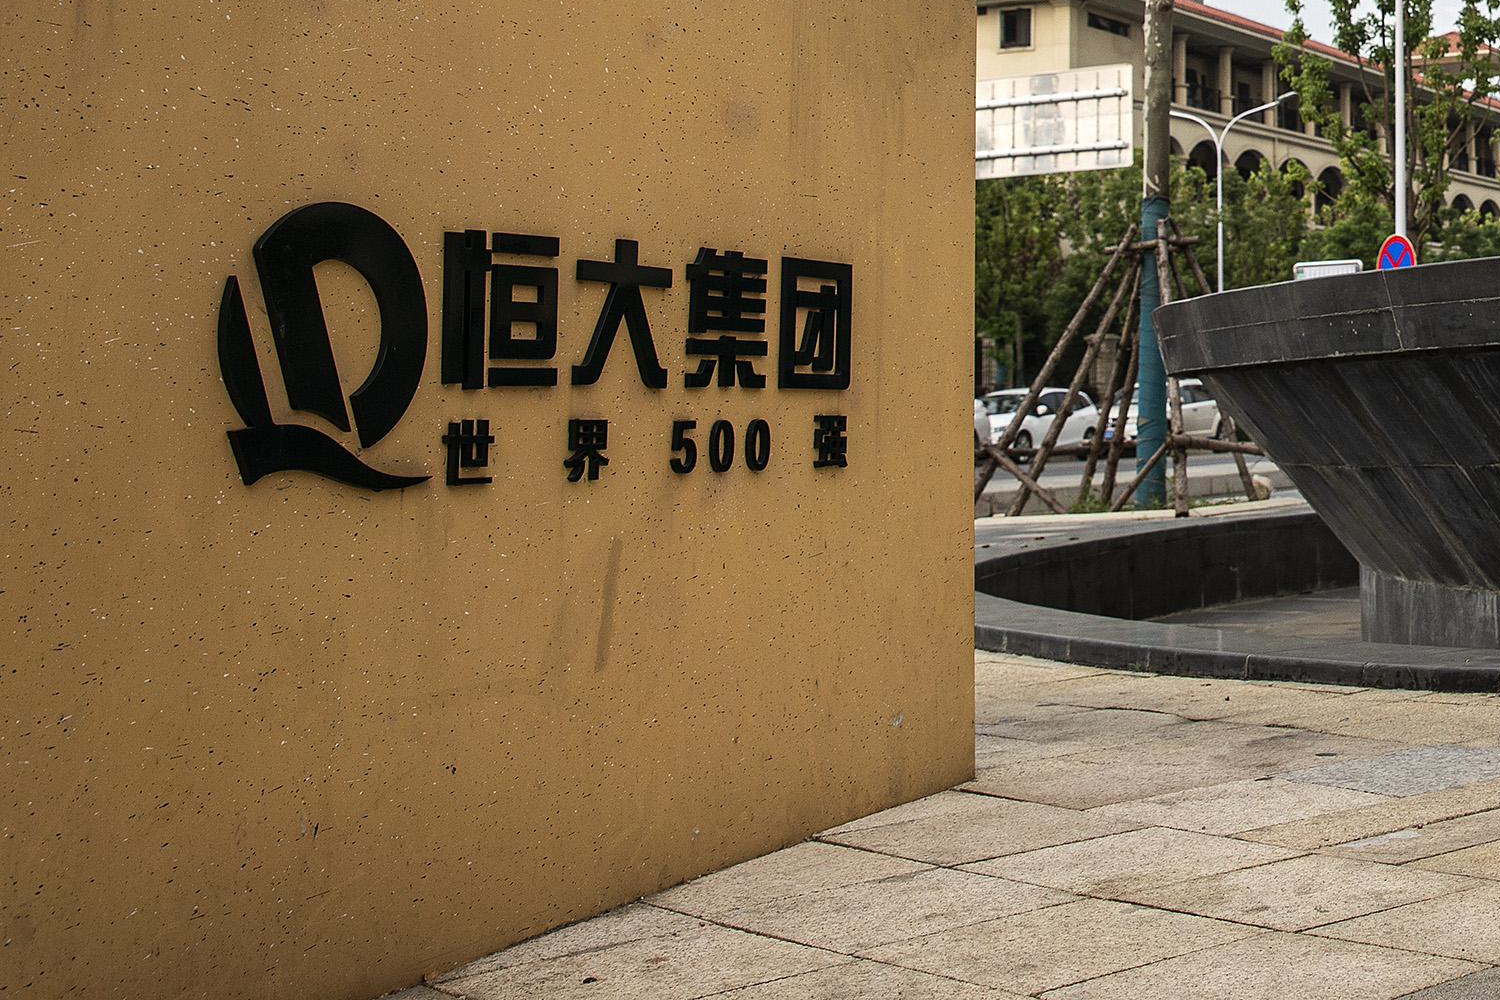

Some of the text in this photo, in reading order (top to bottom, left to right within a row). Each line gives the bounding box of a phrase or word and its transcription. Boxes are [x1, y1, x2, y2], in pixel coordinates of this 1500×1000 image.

[441, 229, 854, 391] 恒大集团
[442, 413, 849, 487] 世界500强
